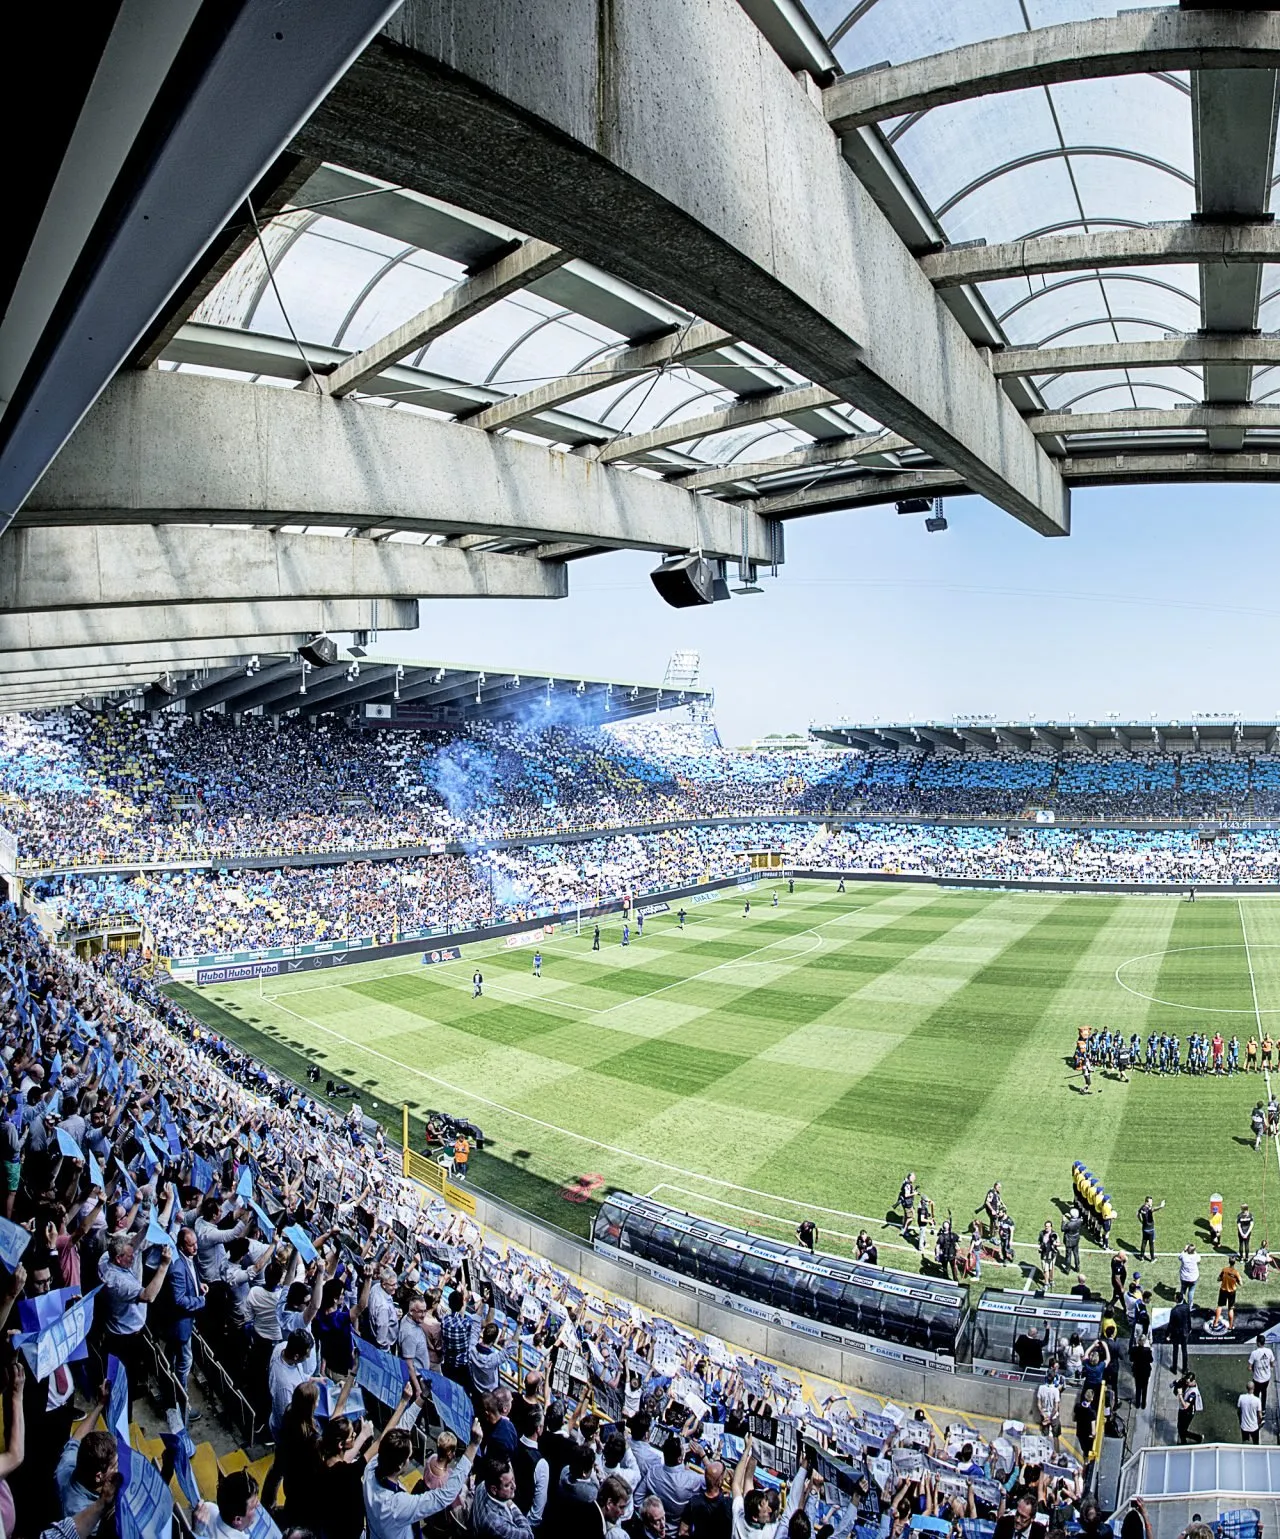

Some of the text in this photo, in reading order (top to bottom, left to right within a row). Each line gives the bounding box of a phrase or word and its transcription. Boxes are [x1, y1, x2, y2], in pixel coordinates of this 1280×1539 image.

[201, 965, 277, 981] Hubo Hubo Hubo
[754, 1250, 777, 1259] DAIKIN
[806, 1264, 828, 1274] DAIKIN
[883, 1284, 908, 1293] DAIKIN
[744, 1307, 767, 1318] DAIKIN
[796, 1324, 819, 1335] DAIKIN
[876, 1348, 901, 1358] DAIKIN
[930, 1361, 951, 1371] macron
